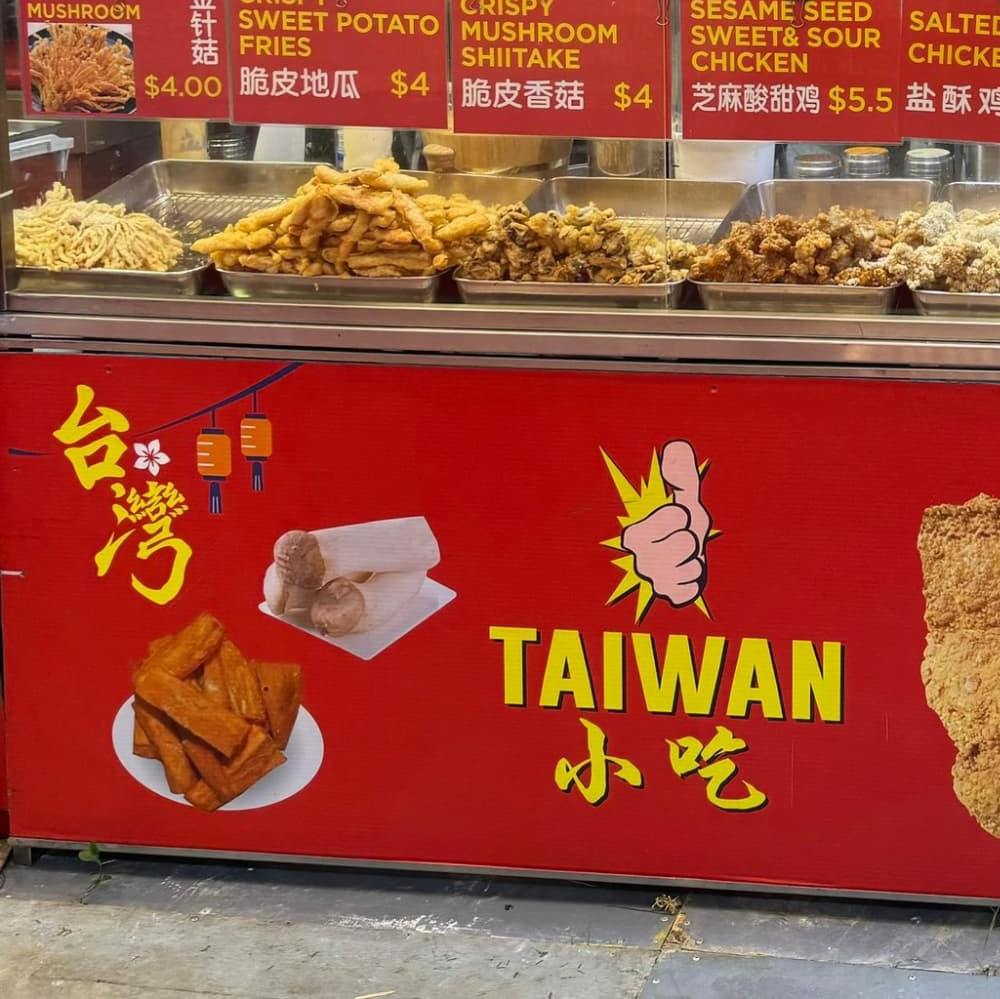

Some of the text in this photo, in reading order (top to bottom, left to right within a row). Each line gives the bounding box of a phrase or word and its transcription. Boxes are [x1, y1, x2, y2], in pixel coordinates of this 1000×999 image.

[27, 3, 141, 20] MUSHROOM
[239, 9, 440, 36] SWEET POTATO
[803, 0, 873, 23] SEED
[239, 35, 312, 57] FRIES
[461, 21, 618, 45] MUSHROOM
[690, 25, 881, 50] SWEET& SOUR
[461, 46, 581, 70] SHIITAKE
[691, 51, 809, 74] CHICKEN
[144, 74, 222, 98] $4.00
[239, 66, 360, 100] 脆皮地瓜
[390, 69, 430, 98] $4
[461, 78, 585, 111] 脆皮香菇
[613, 80, 653, 110] $4
[691, 81, 821, 115] 芝麻酸甜鸡
[828, 83, 893, 115] $5.5
[488, 625, 846, 725] TAIWAN
[554, 717, 769, 812] 小吃
